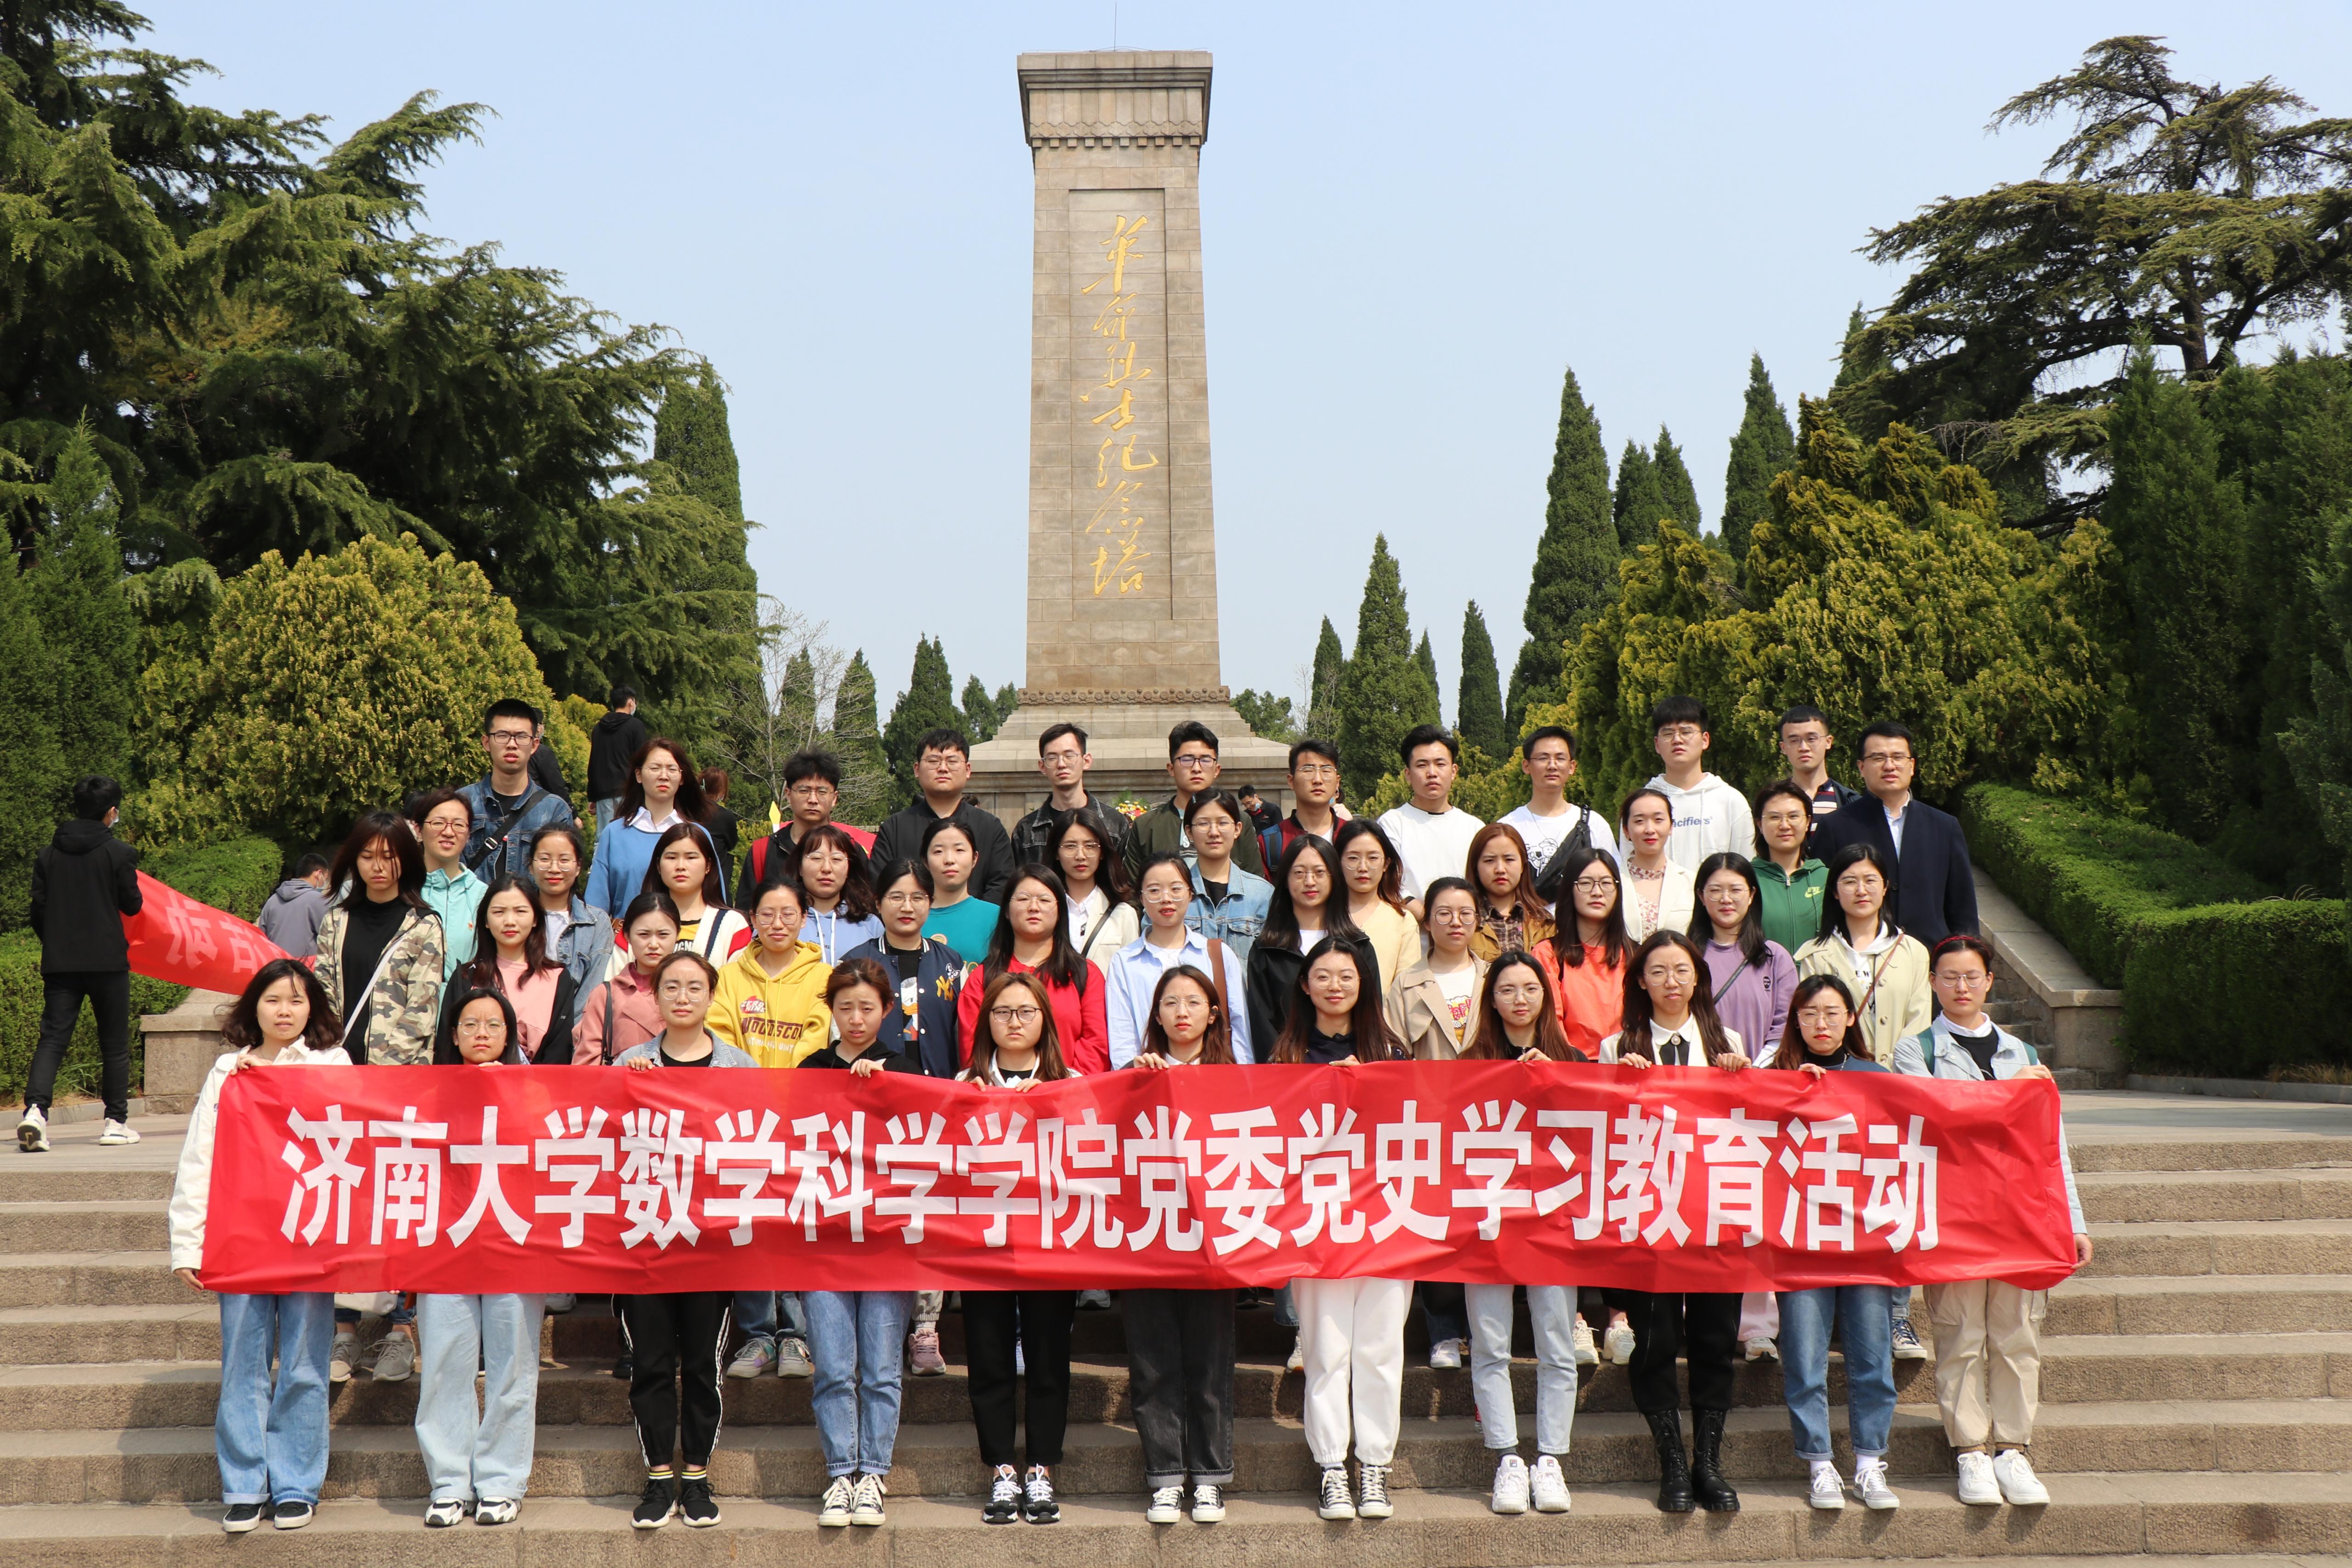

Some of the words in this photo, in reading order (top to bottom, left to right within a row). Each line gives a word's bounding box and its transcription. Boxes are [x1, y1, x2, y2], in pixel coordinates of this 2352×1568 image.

[1672, 817, 1710, 827] acifiers
[280, 1099, 1938, 1255] 济南大学数学科学学院党委党史学习教育活动
